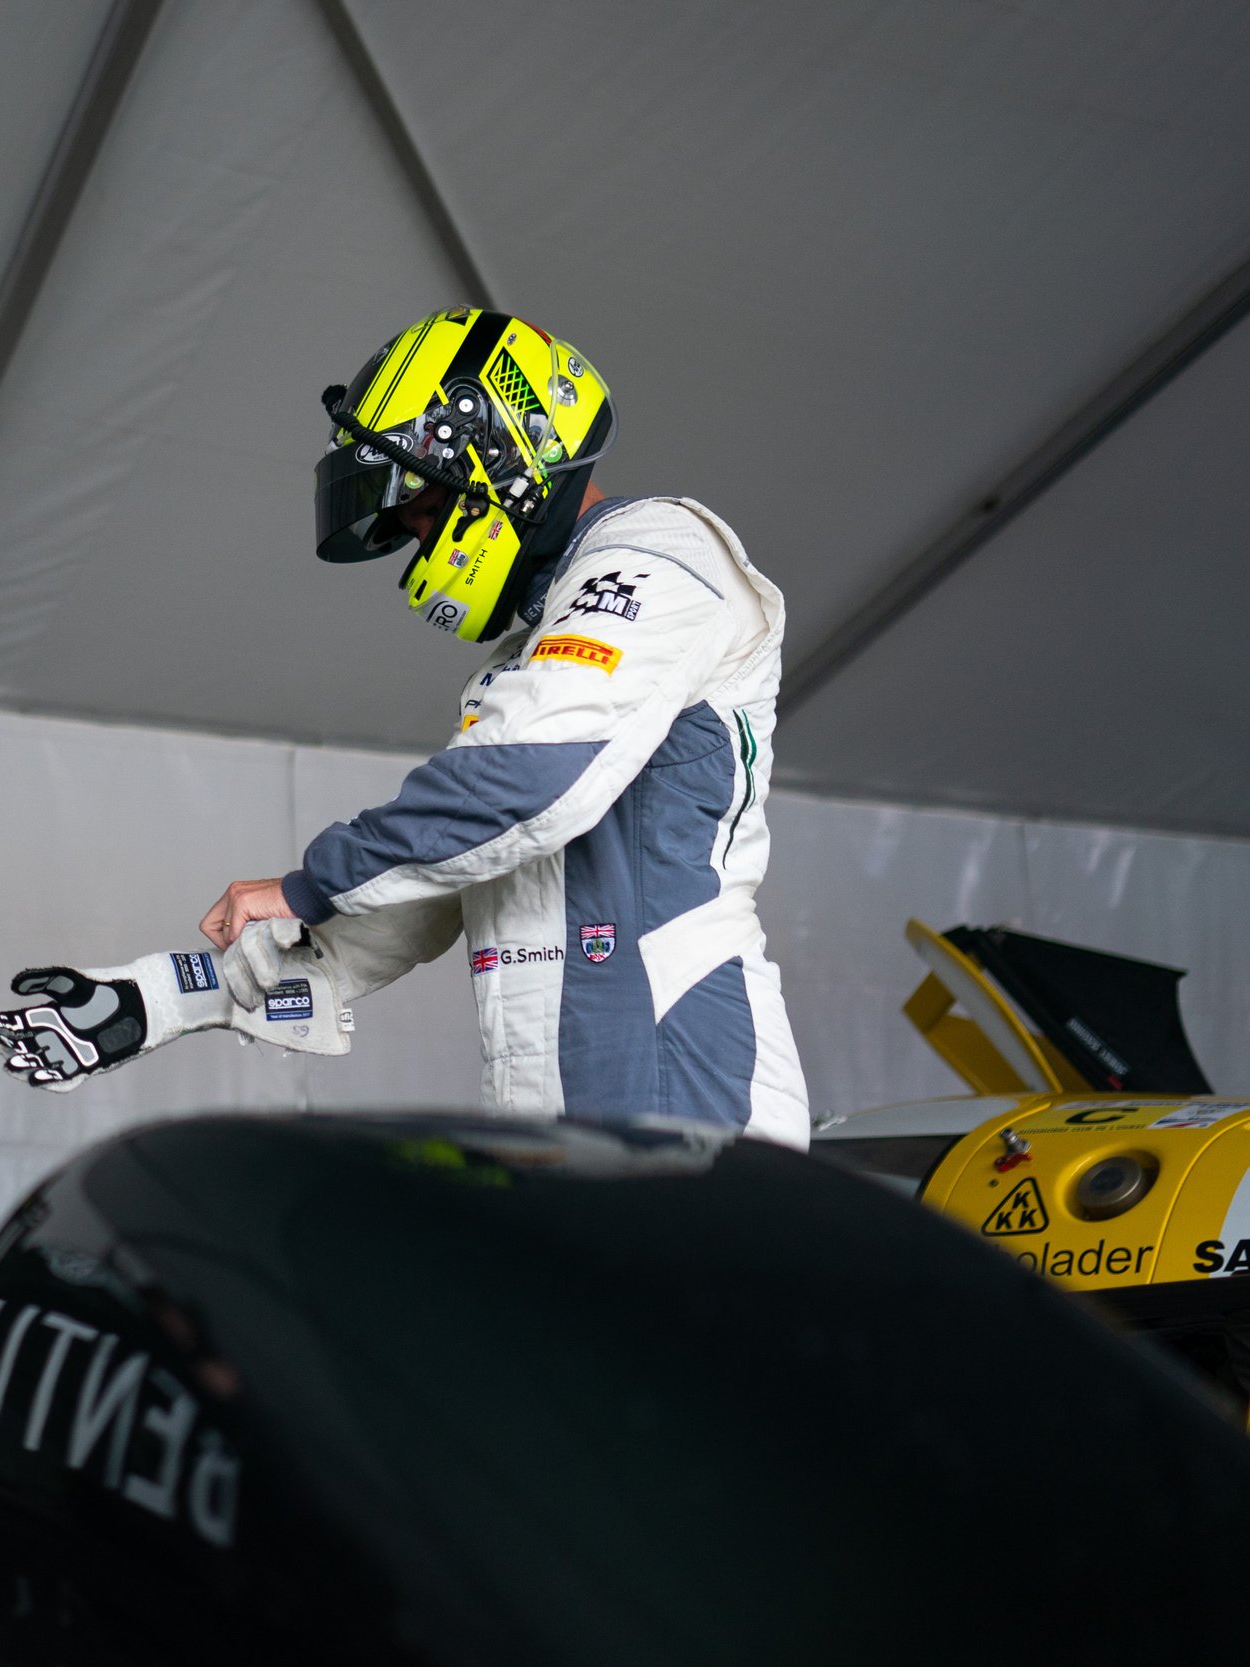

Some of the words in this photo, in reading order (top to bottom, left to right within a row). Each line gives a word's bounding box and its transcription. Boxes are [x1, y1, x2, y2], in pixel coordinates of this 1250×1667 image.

[465, 549, 488, 585] SMITH
[433, 604, 458, 632] RO
[627, 600, 641, 620] SPORT
[501, 946, 564, 965] G.Smith
[268, 996, 310, 1009] sparco
[1011, 1191, 1031, 1210] K
[1013, 1239, 1154, 1279] olader
